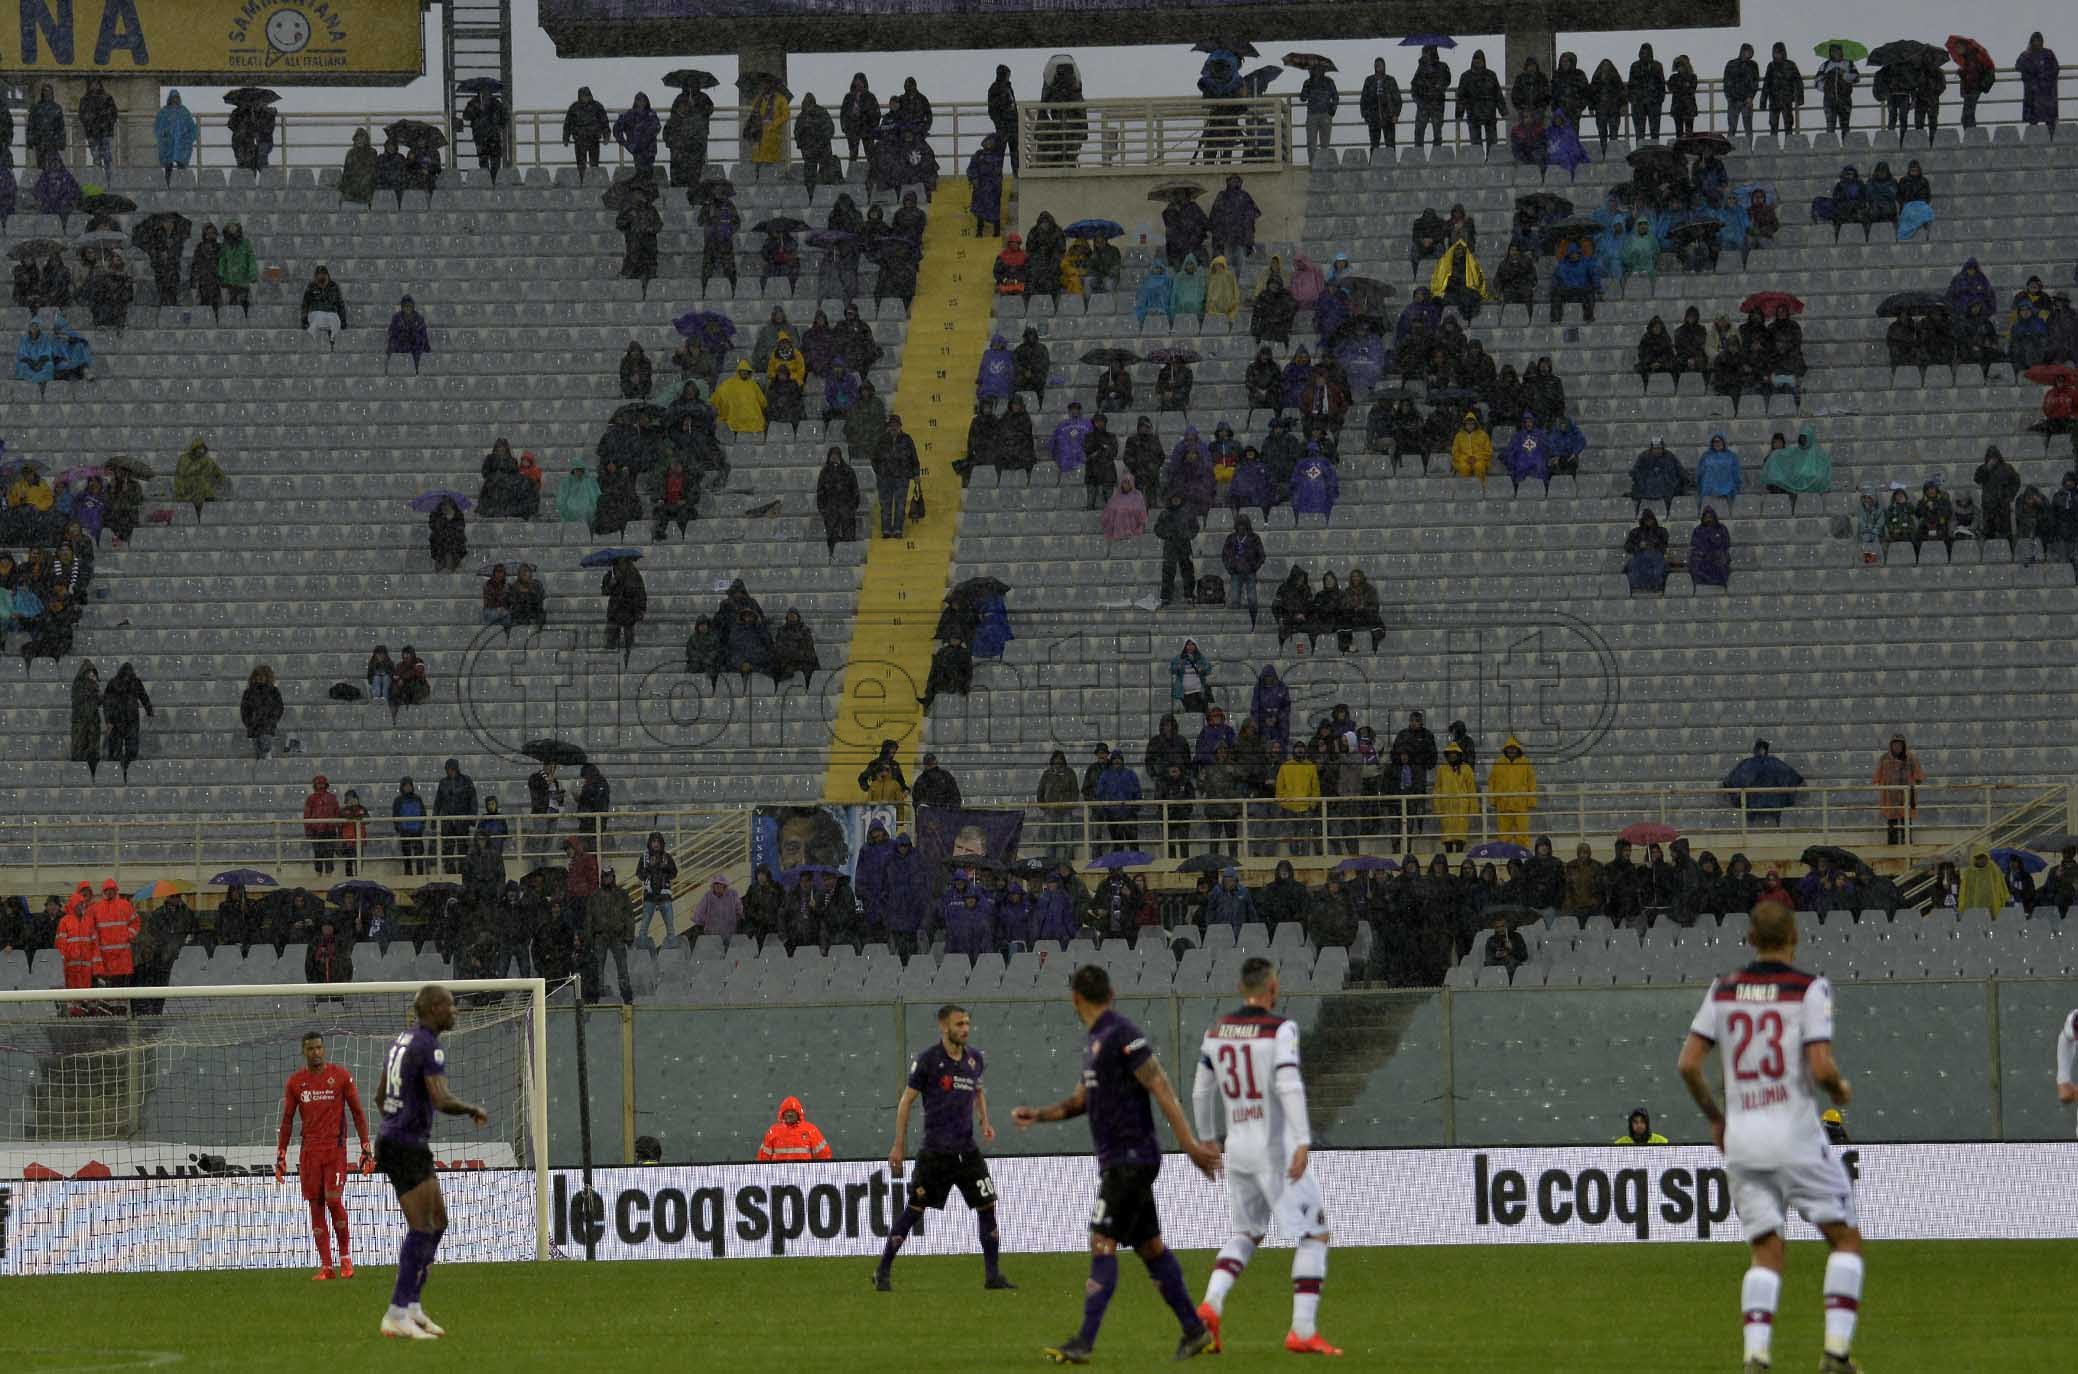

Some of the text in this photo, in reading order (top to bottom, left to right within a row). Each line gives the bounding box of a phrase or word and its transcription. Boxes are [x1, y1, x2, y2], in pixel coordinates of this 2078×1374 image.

[0, 0, 150, 65] NA
[755, 808, 764, 865] VIEUSS
[386, 1045, 407, 1098] 14
[1217, 1044, 1263, 1100] 31
[1727, 1009, 1785, 1081] 23
[552, 1173, 605, 1247] le
[614, 1186, 726, 1257] coq
[976, 1179, 994, 1198] 20
[1474, 1154, 1527, 1226] le
[1537, 1167, 1649, 1240] coq
